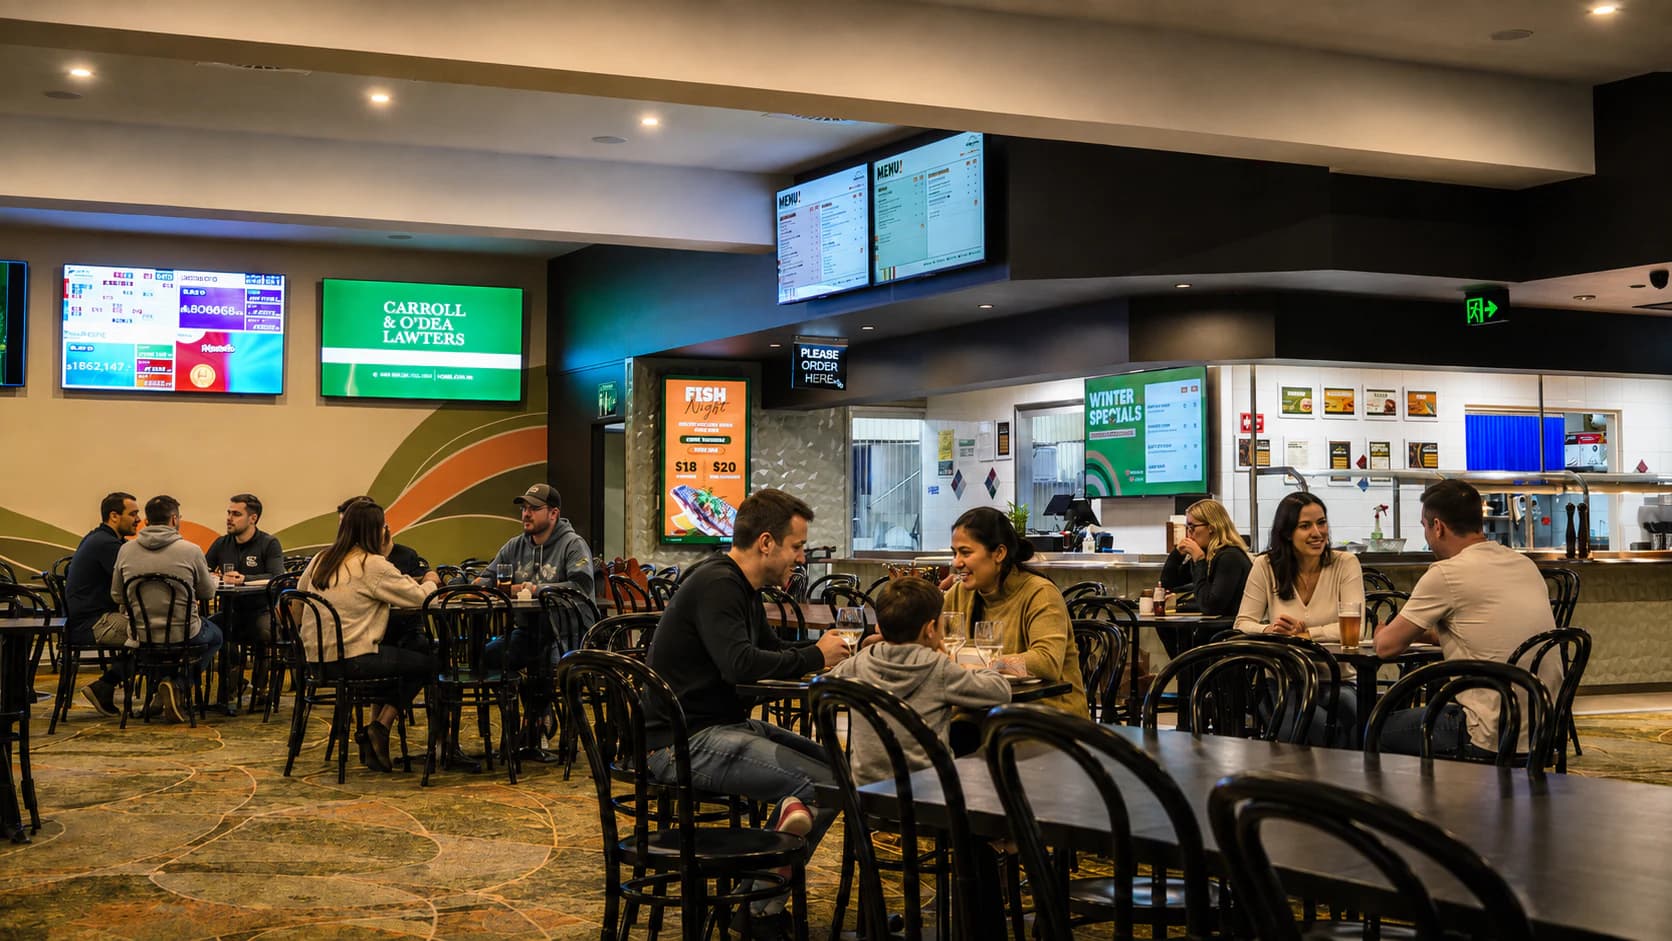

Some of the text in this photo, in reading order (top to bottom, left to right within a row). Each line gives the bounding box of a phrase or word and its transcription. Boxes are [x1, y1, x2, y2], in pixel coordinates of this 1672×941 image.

[383, 301, 466, 317] CARROLL
[383, 316, 454, 331] & O'DEA
[801, 348, 839, 360] PLEASE
[801, 360, 838, 372] ORDER
[805, 373, 834, 384] HERE
[685, 387, 726, 402] FISH
[1089, 388, 1134, 408] WINTER
[685, 400, 728, 419] Night
[1089, 405, 1142, 426] SPECIALS
[675, 461, 737, 473] $18 $20
